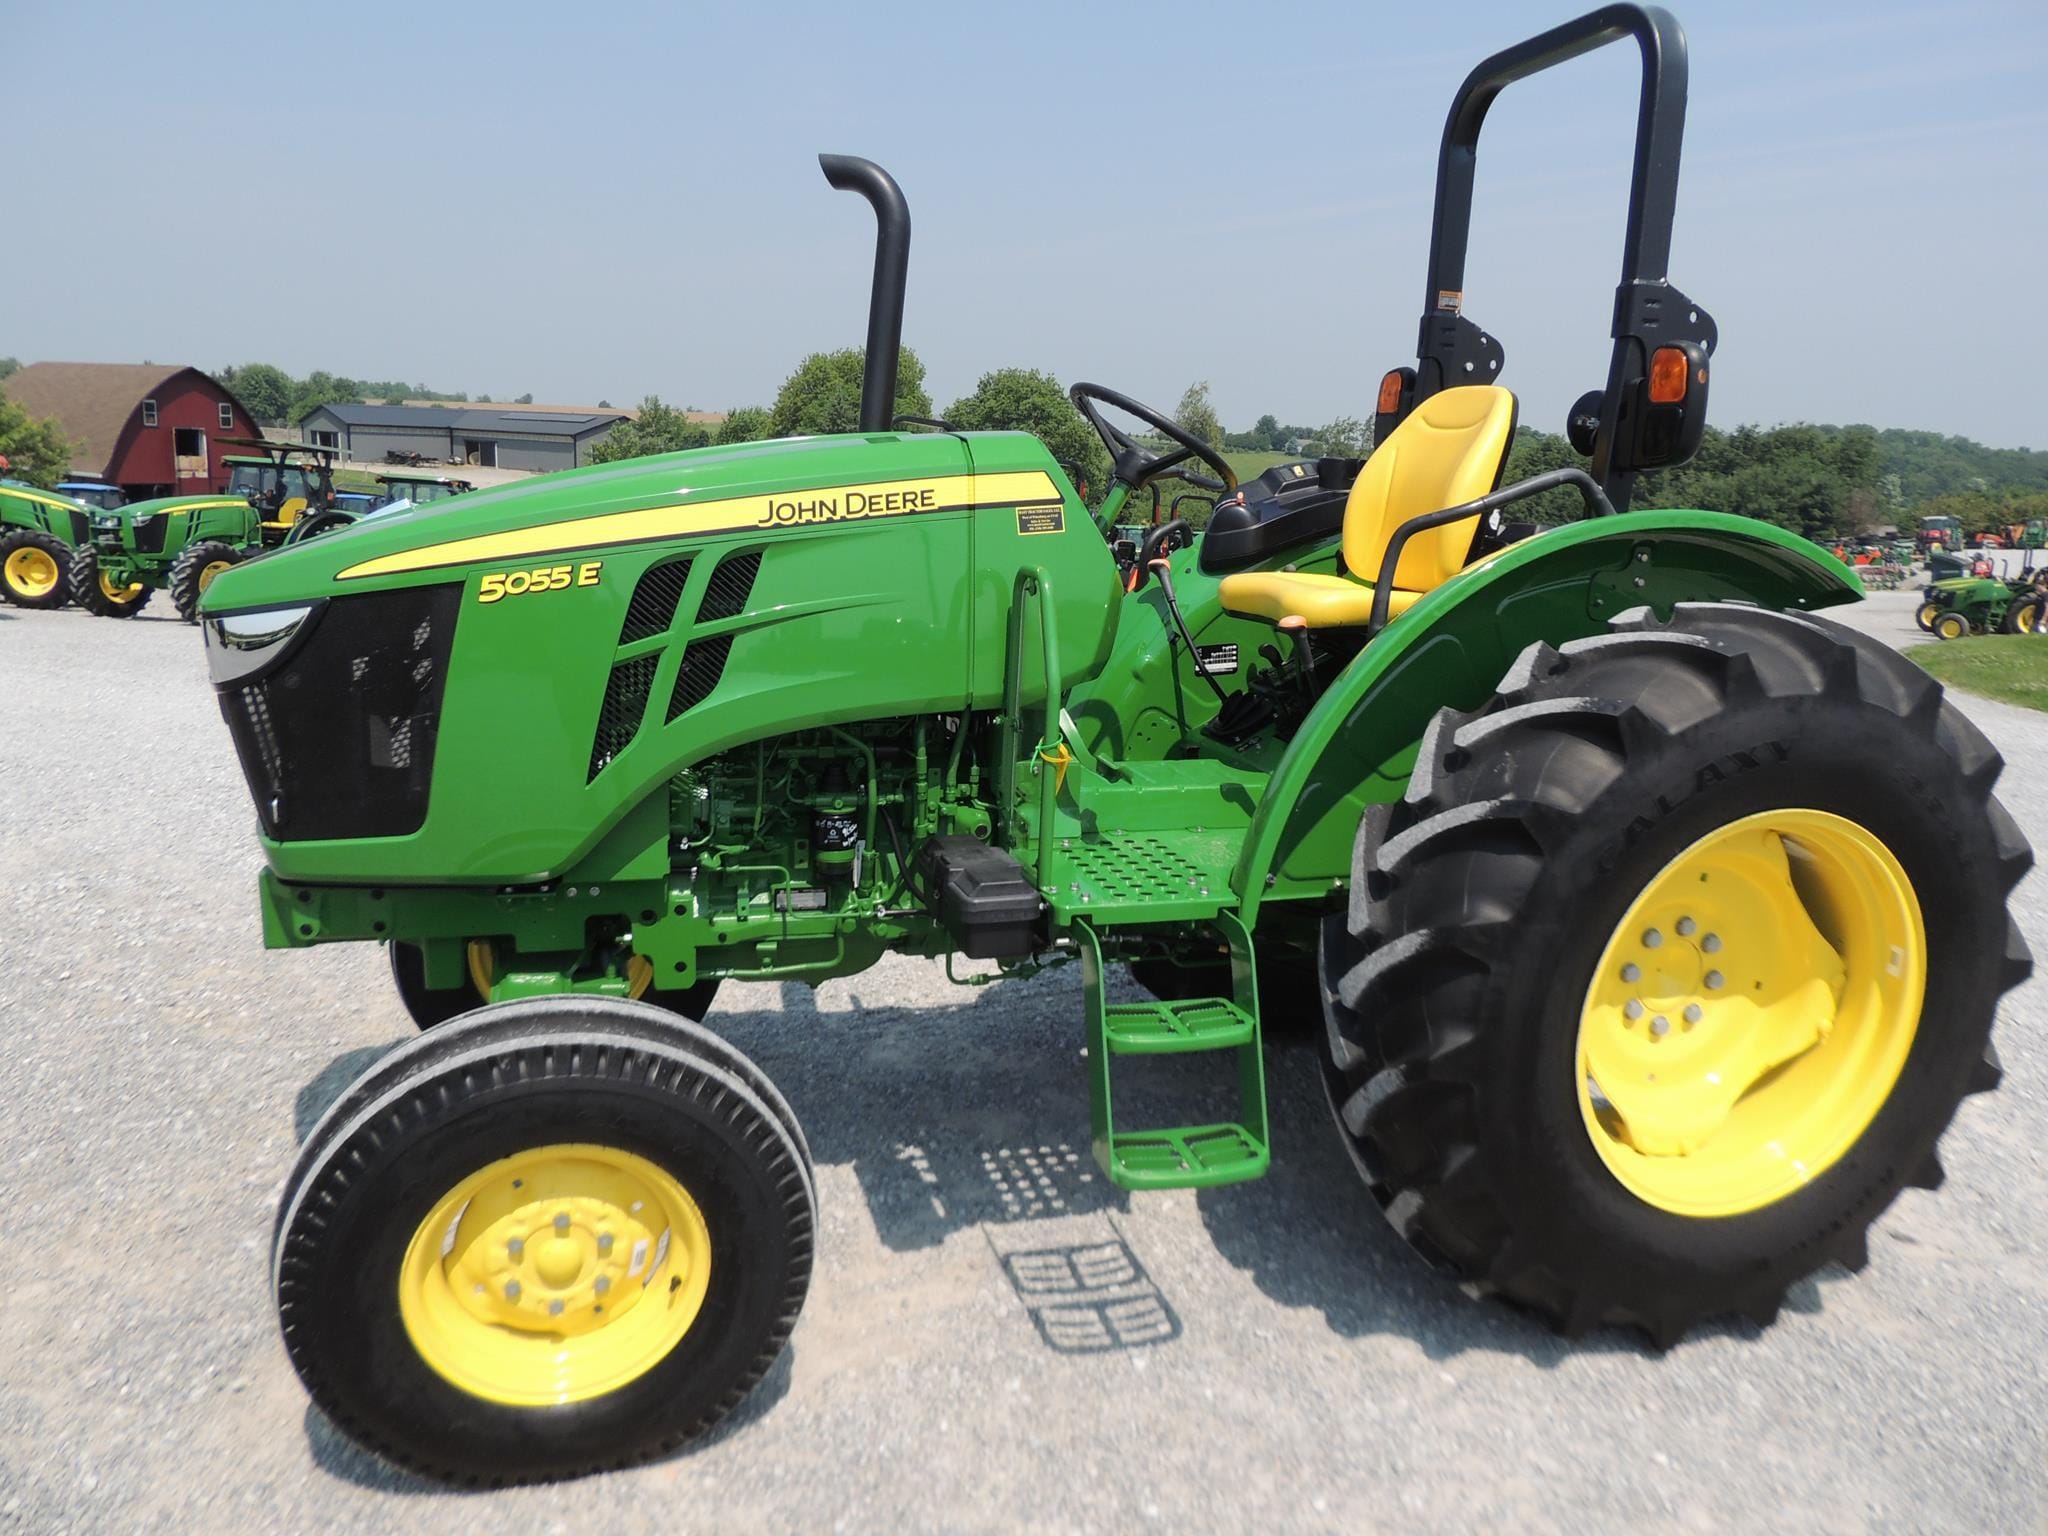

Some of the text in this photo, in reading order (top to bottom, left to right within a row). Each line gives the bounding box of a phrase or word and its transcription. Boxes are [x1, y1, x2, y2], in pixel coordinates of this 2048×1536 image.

[758, 488, 936, 524] JOHN DEERE
[478, 561, 603, 604] 5055 E
[1597, 737, 1795, 876] GALAXY
